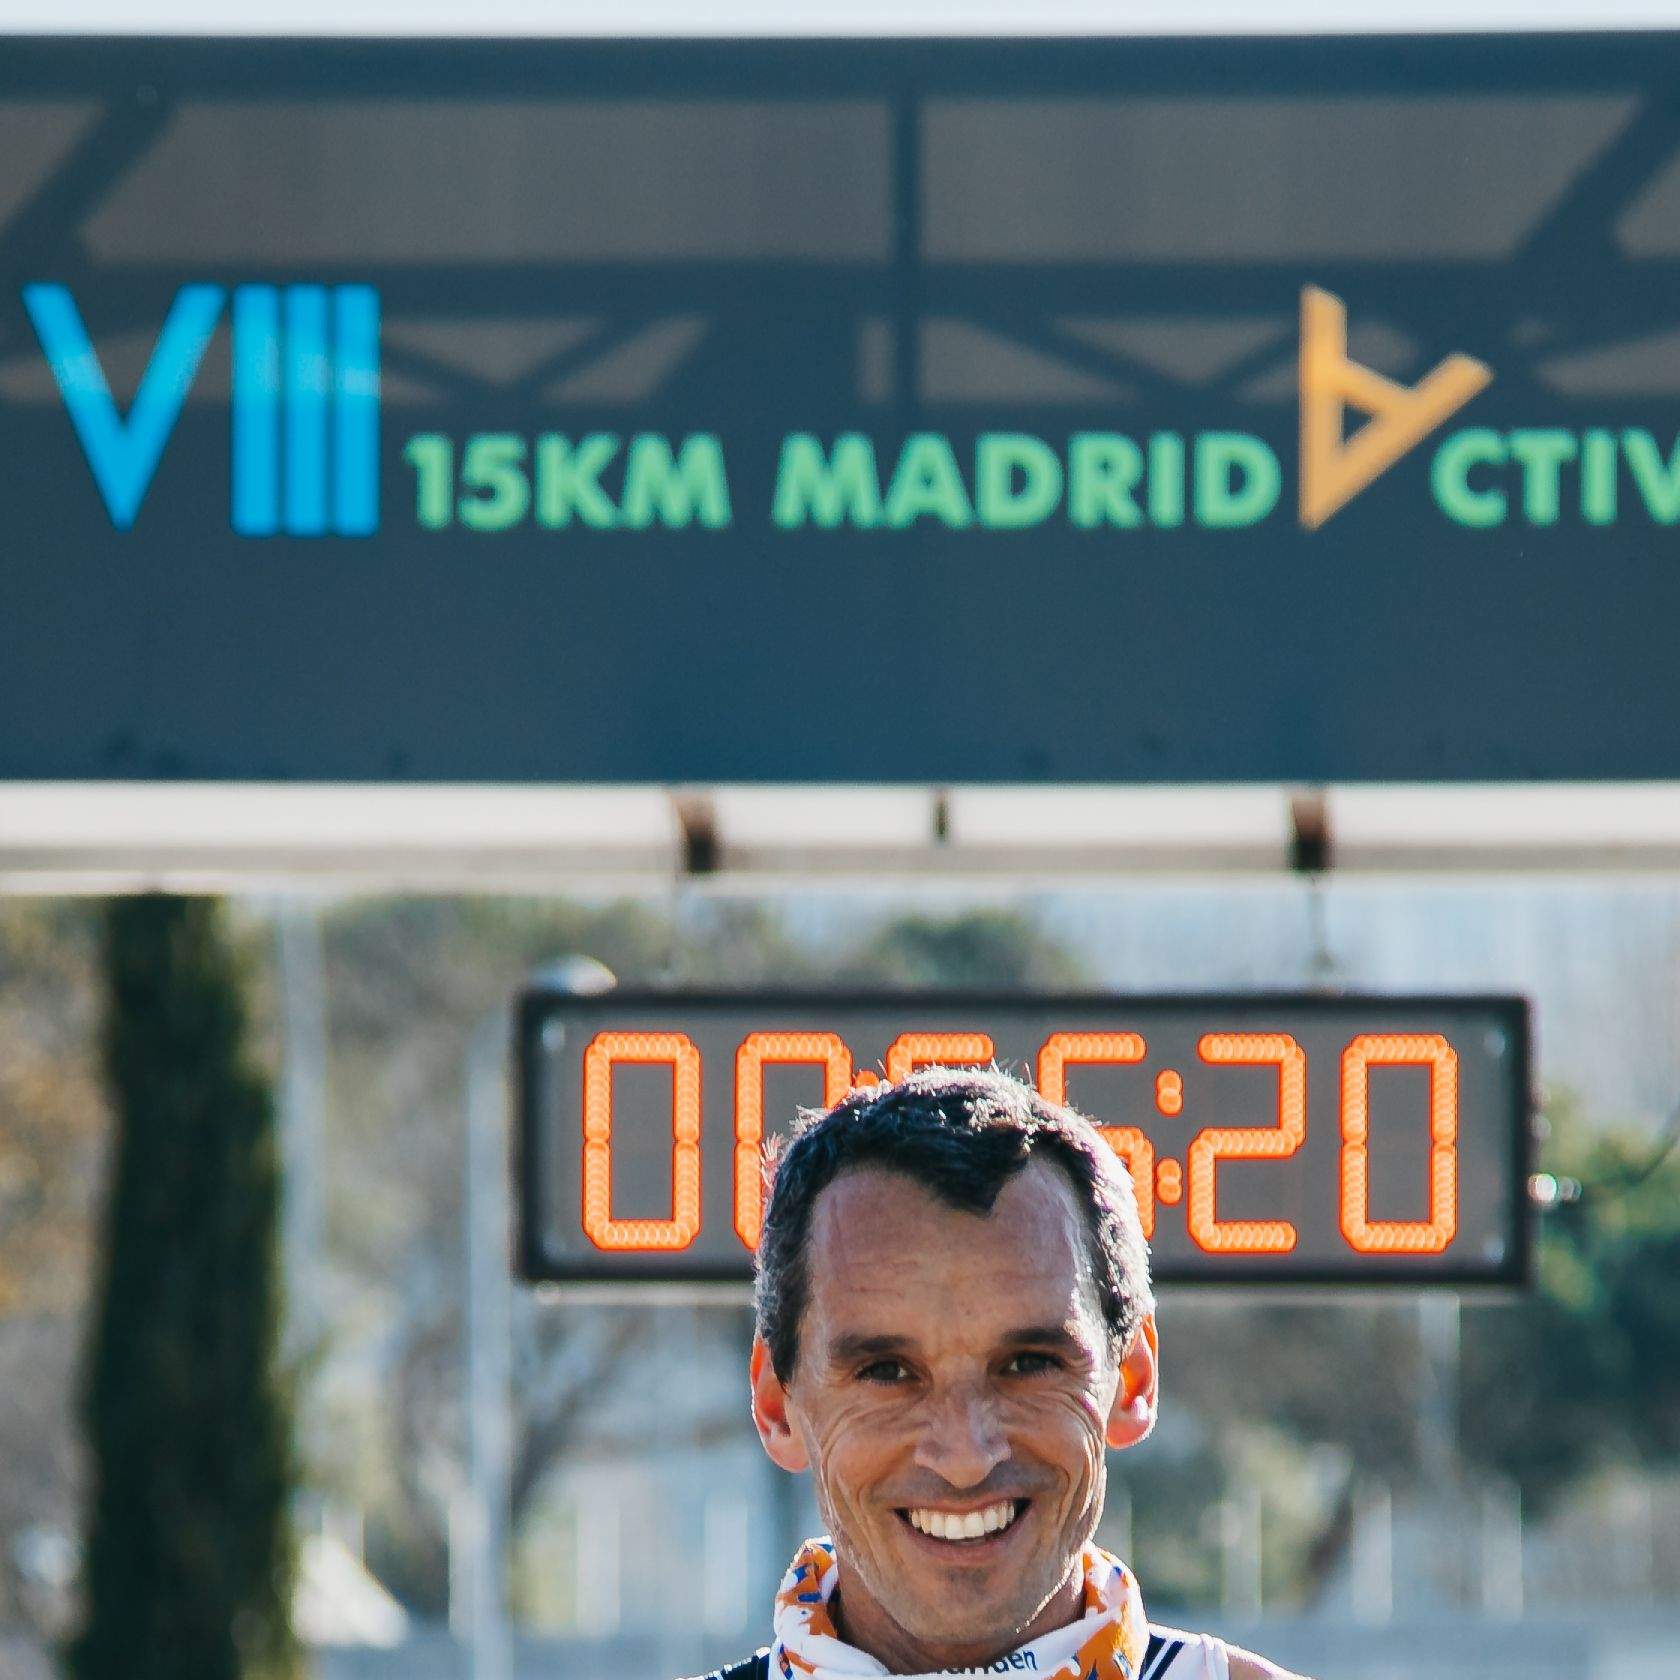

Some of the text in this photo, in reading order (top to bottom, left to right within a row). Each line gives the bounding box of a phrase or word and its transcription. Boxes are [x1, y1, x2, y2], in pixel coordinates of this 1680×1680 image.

[19, 281, 382, 537] VIII
[404, 432, 732, 530] 15KM
[771, 431, 1282, 530] MADRID
